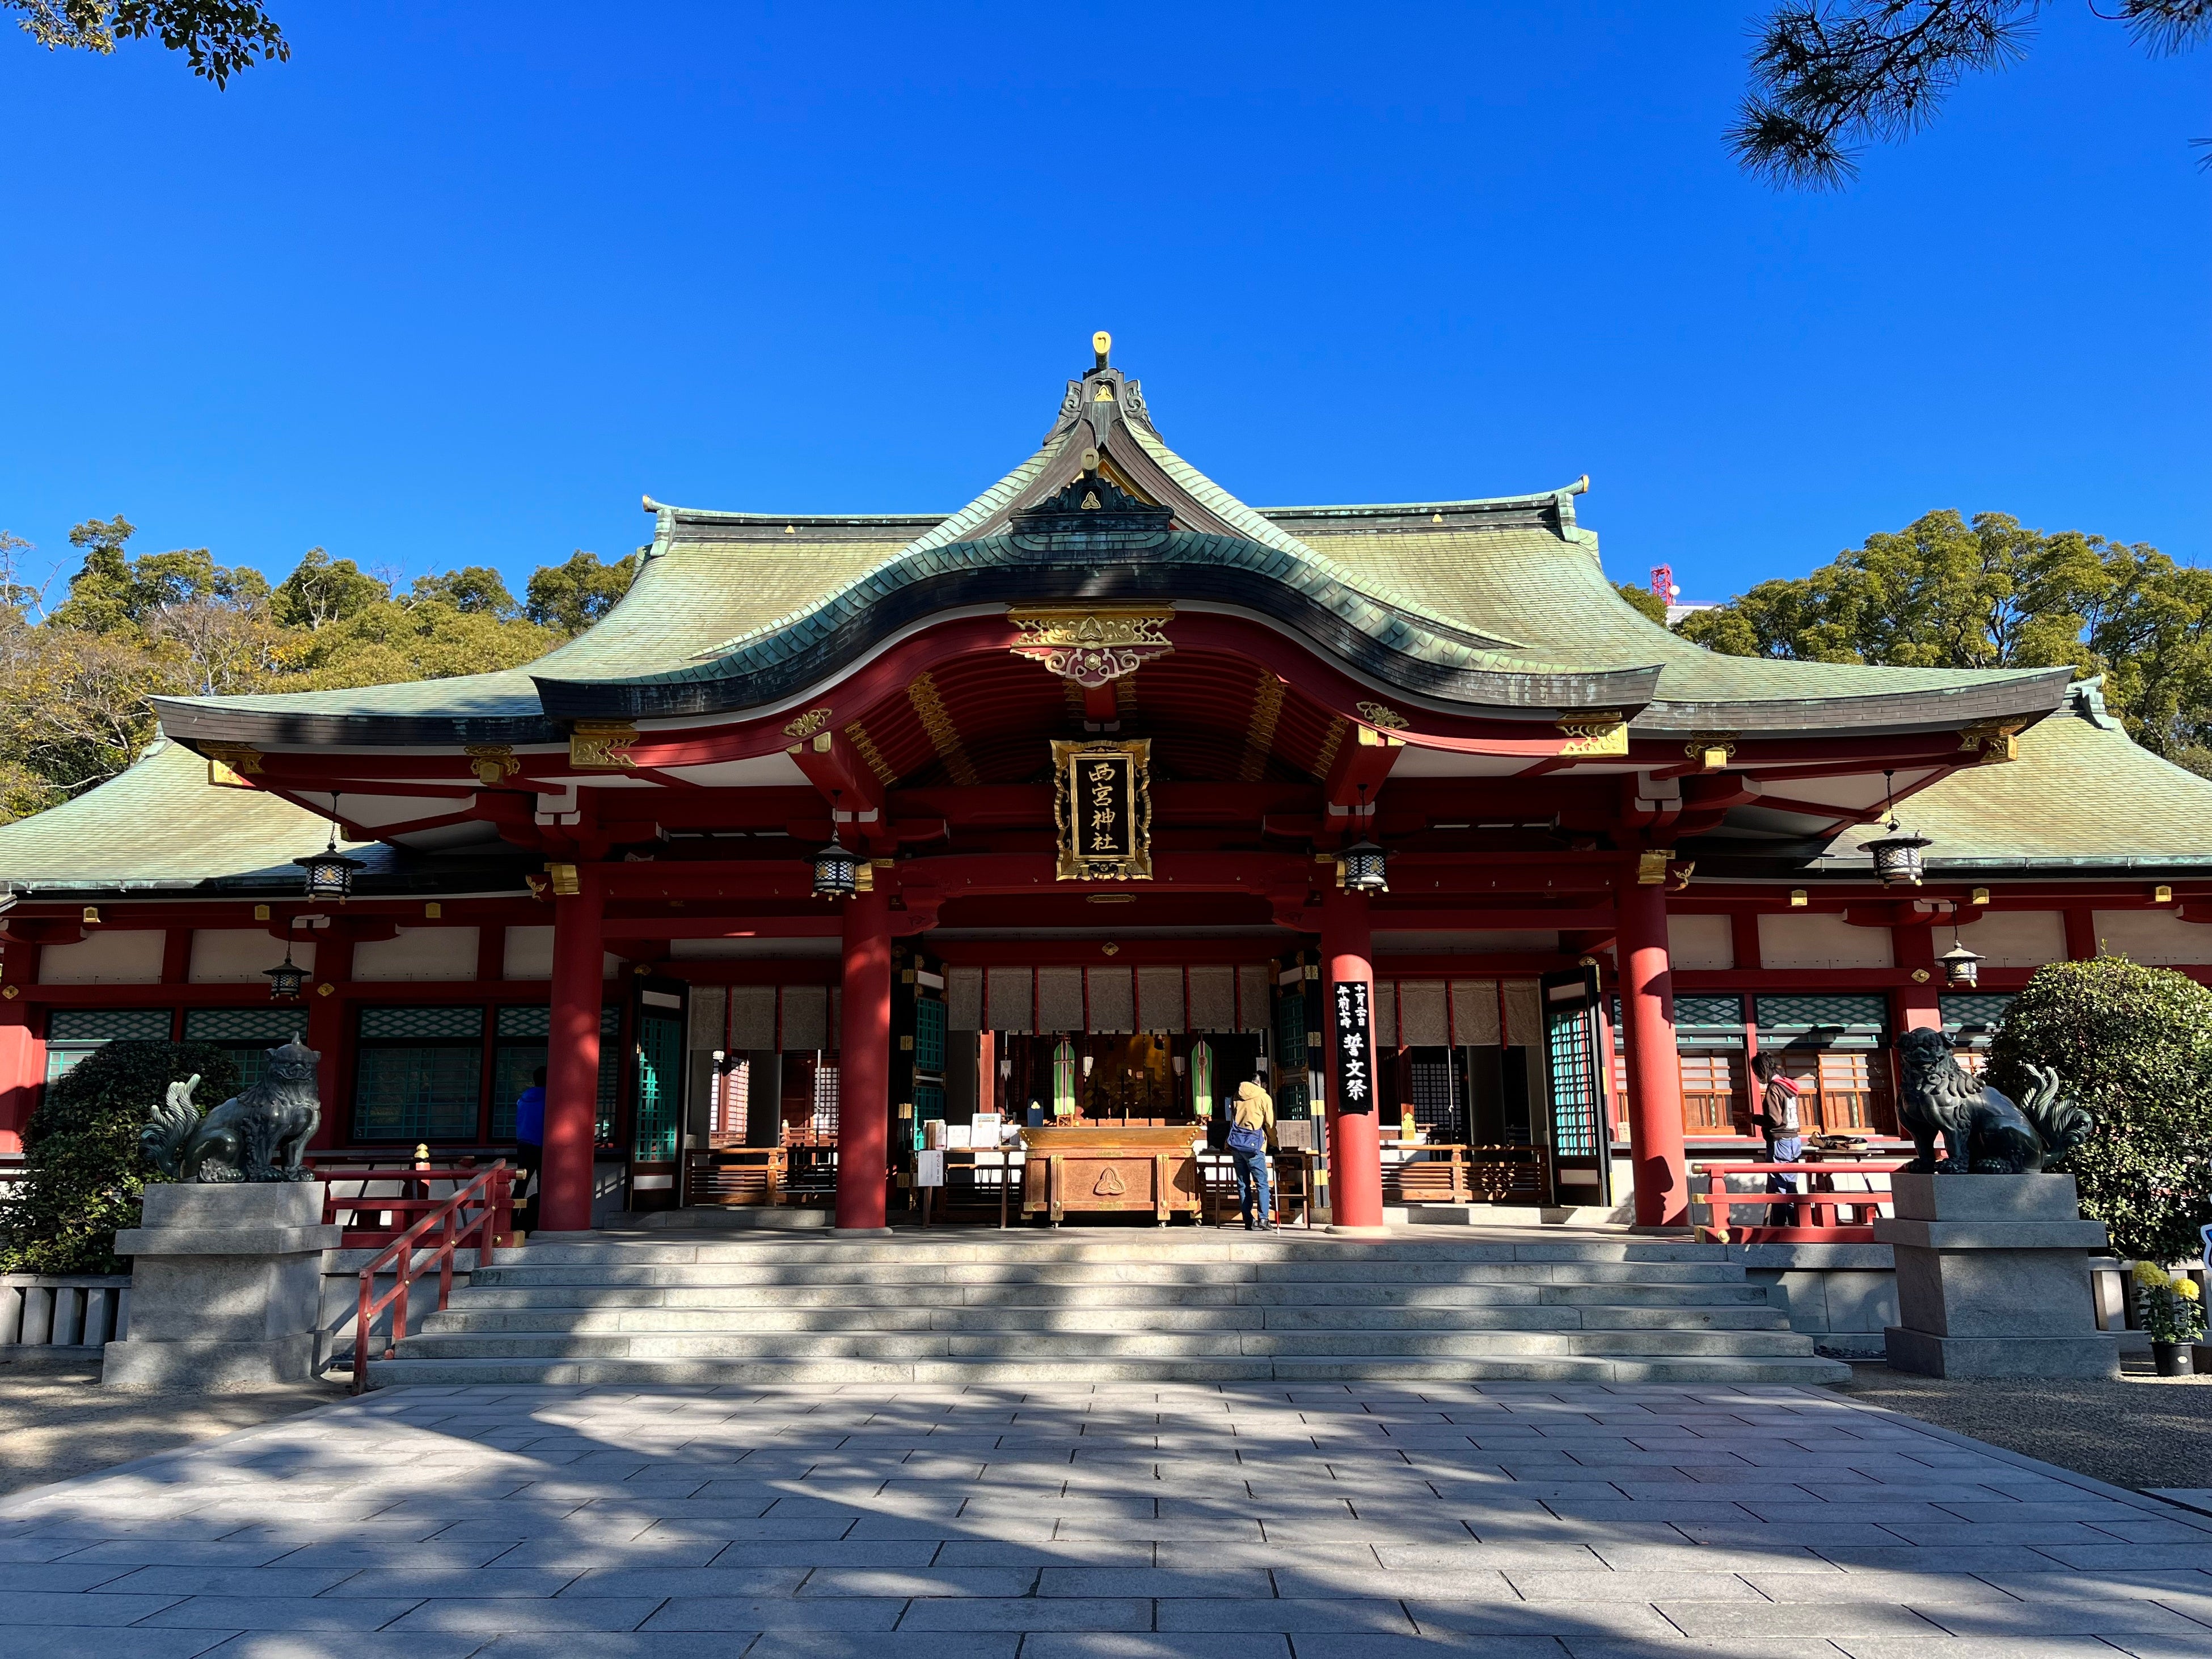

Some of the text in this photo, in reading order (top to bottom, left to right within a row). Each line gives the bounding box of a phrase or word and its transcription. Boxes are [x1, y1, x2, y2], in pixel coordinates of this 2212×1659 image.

[1088, 762, 1118, 851] 西宮神社
[1337, 985, 1352, 1028] 午前十時
[1354, 984, 1367, 1026] 十一月二十日
[1343, 1032, 1367, 1101] 誓文祭
